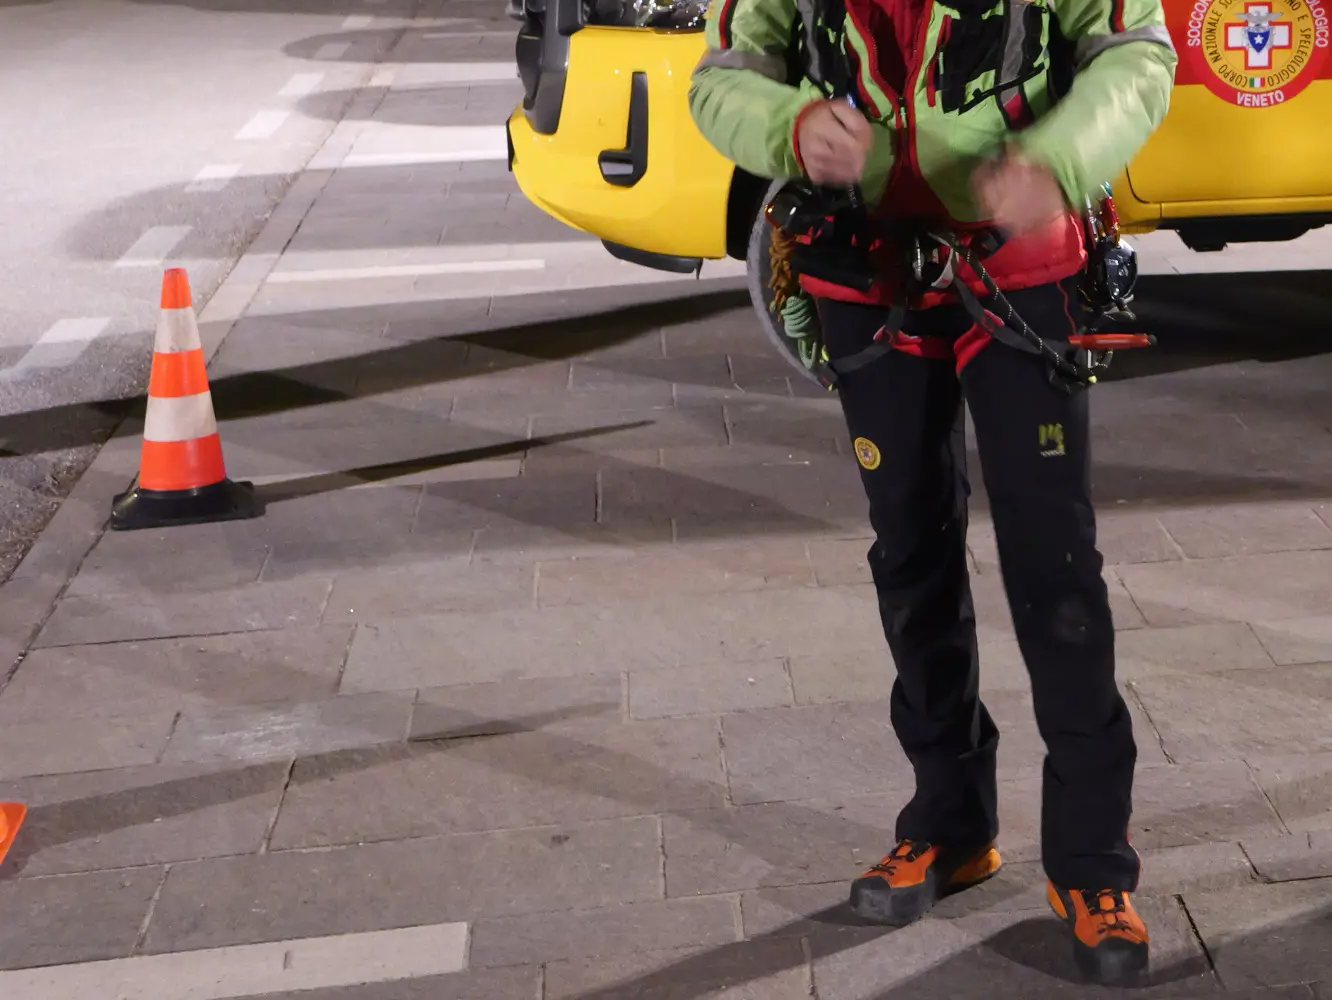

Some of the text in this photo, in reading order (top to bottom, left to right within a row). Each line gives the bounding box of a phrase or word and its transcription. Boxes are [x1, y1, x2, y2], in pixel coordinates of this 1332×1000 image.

[1297, 13, 1309, 22] E
[1204, 8, 1223, 63] NAZIONALE
[1266, 27, 1312, 87] SPELEOLOGICO
[1218, 63, 1248, 88] CORPO
[1236, 89, 1285, 107] VENETO
